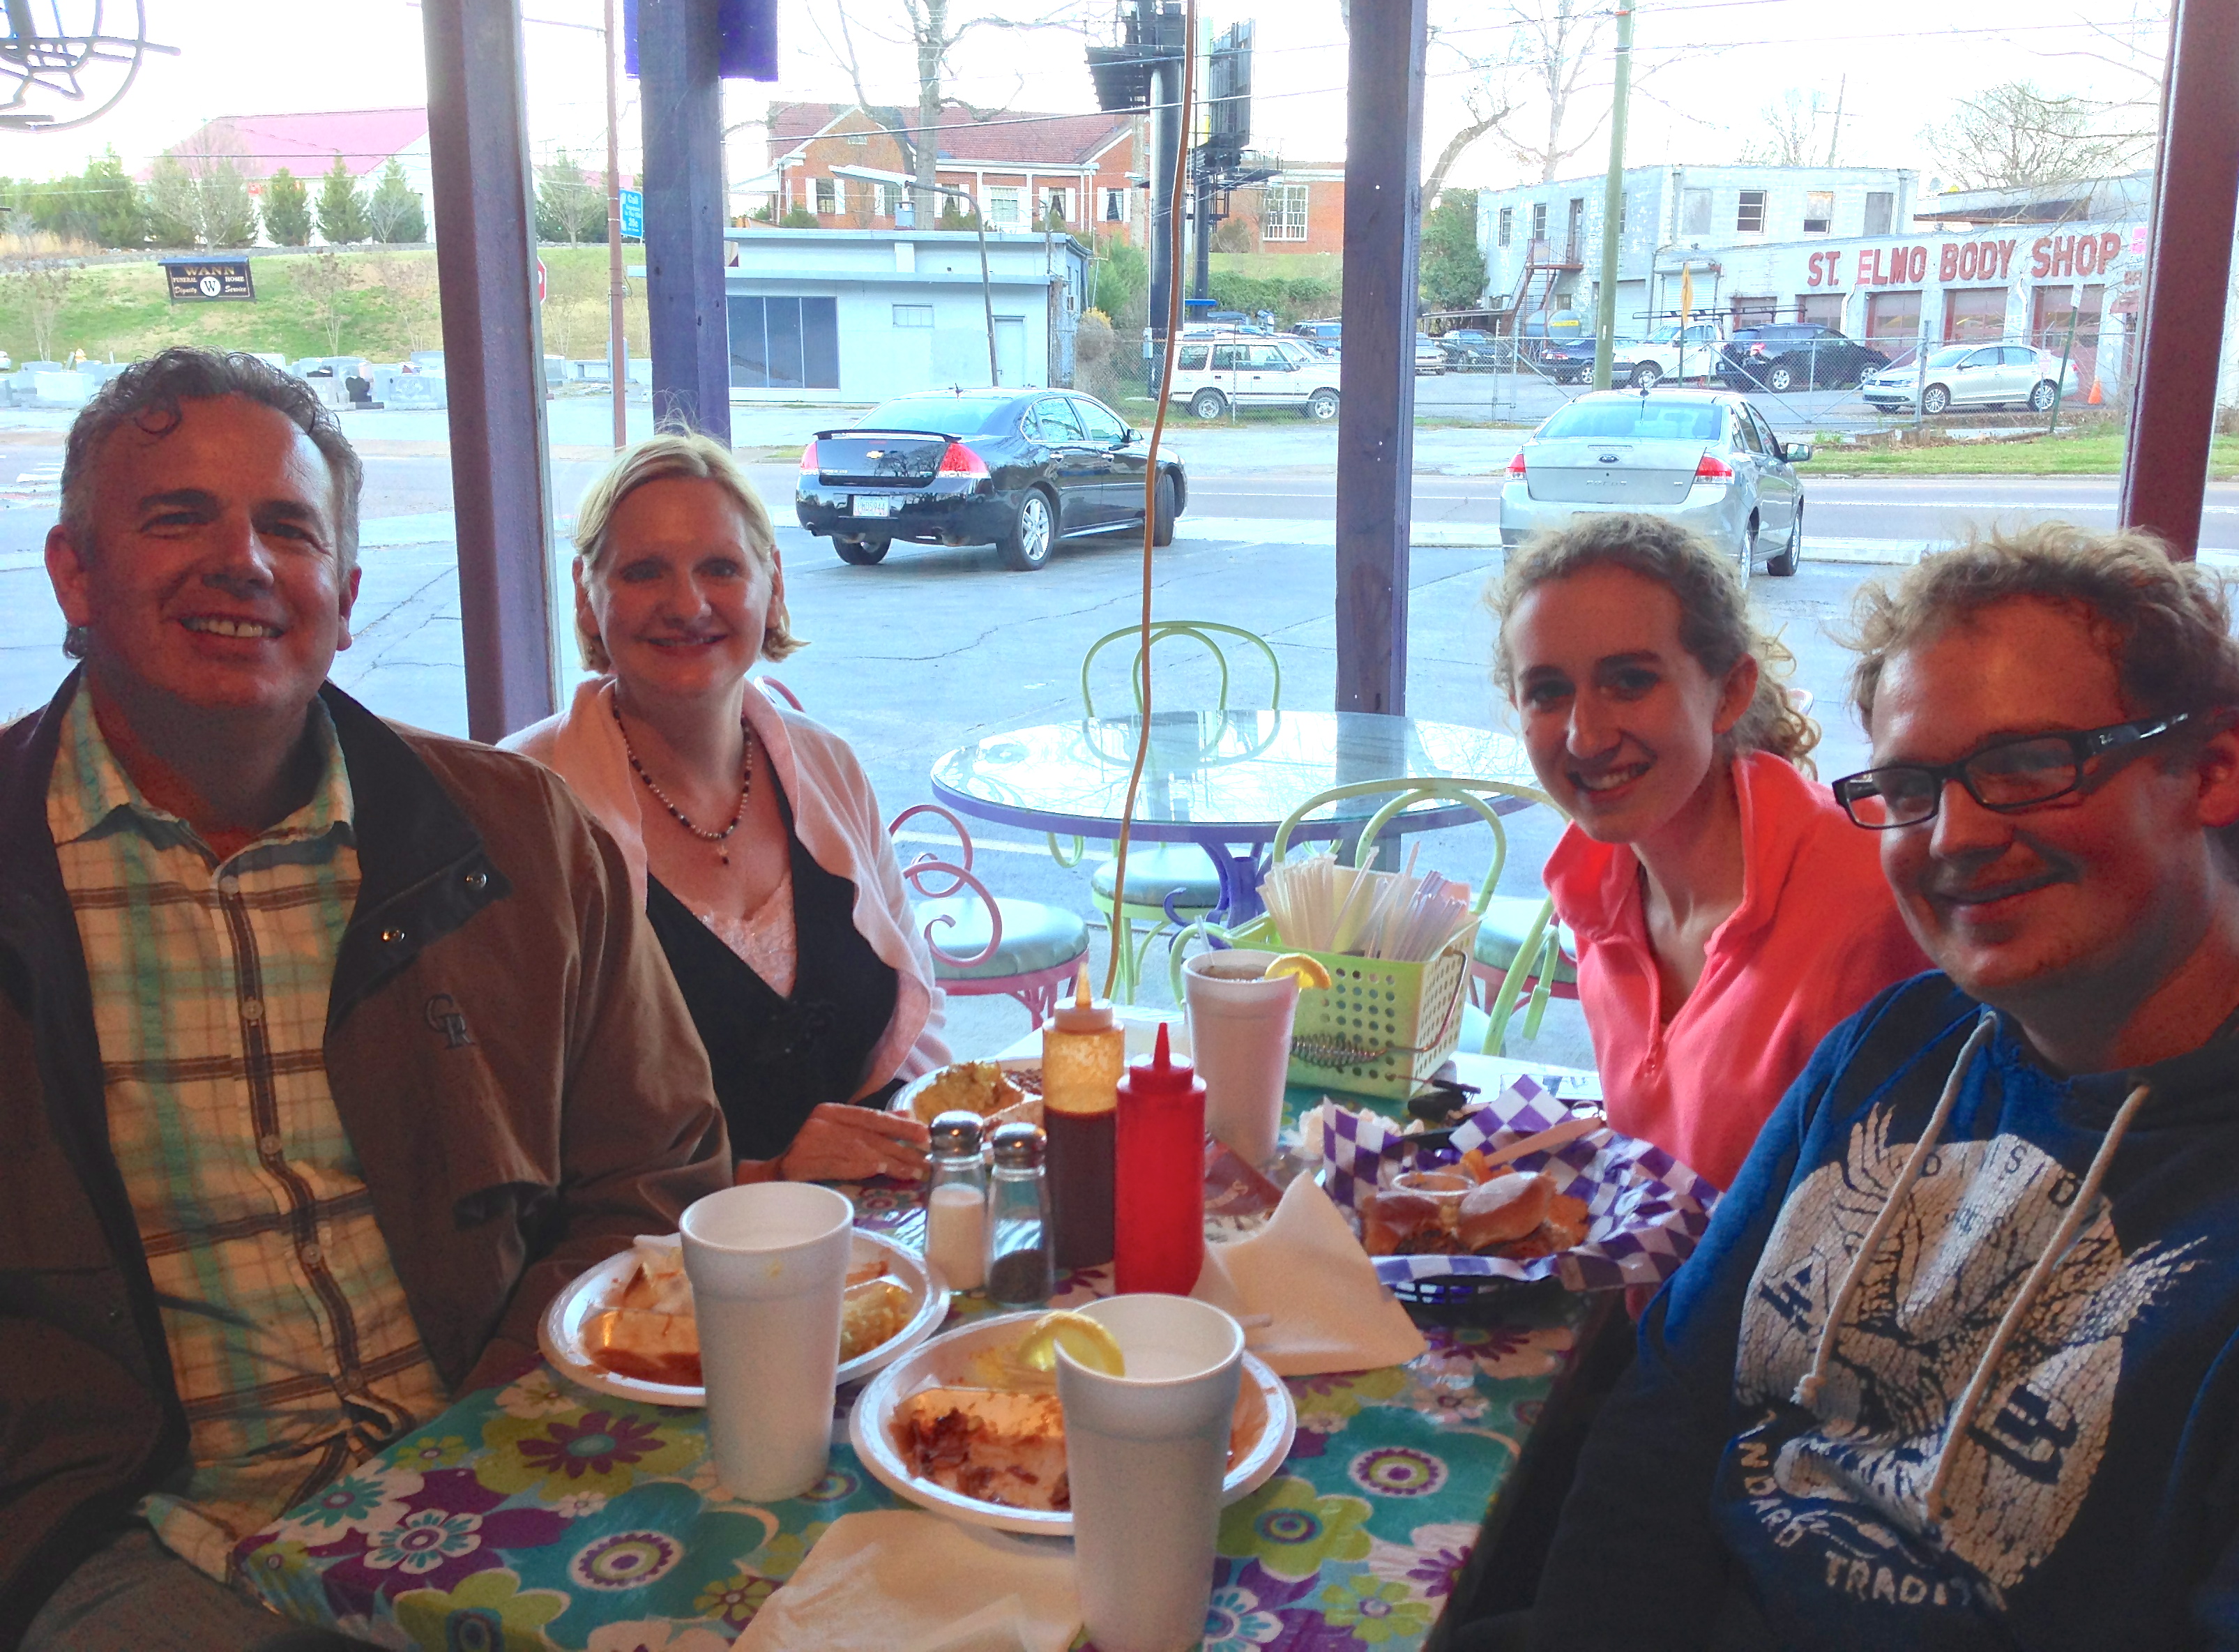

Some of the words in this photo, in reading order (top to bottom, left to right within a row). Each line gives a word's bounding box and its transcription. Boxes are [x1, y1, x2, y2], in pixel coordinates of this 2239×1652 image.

[1807, 251, 1841, 287] ST.
[1856, 246, 1927, 285] ELMO
[1938, 239, 2016, 282] BODY
[2031, 232, 2122, 278] SHOP
[184, 266, 234, 275] WANN
[204, 280, 215, 292] W
